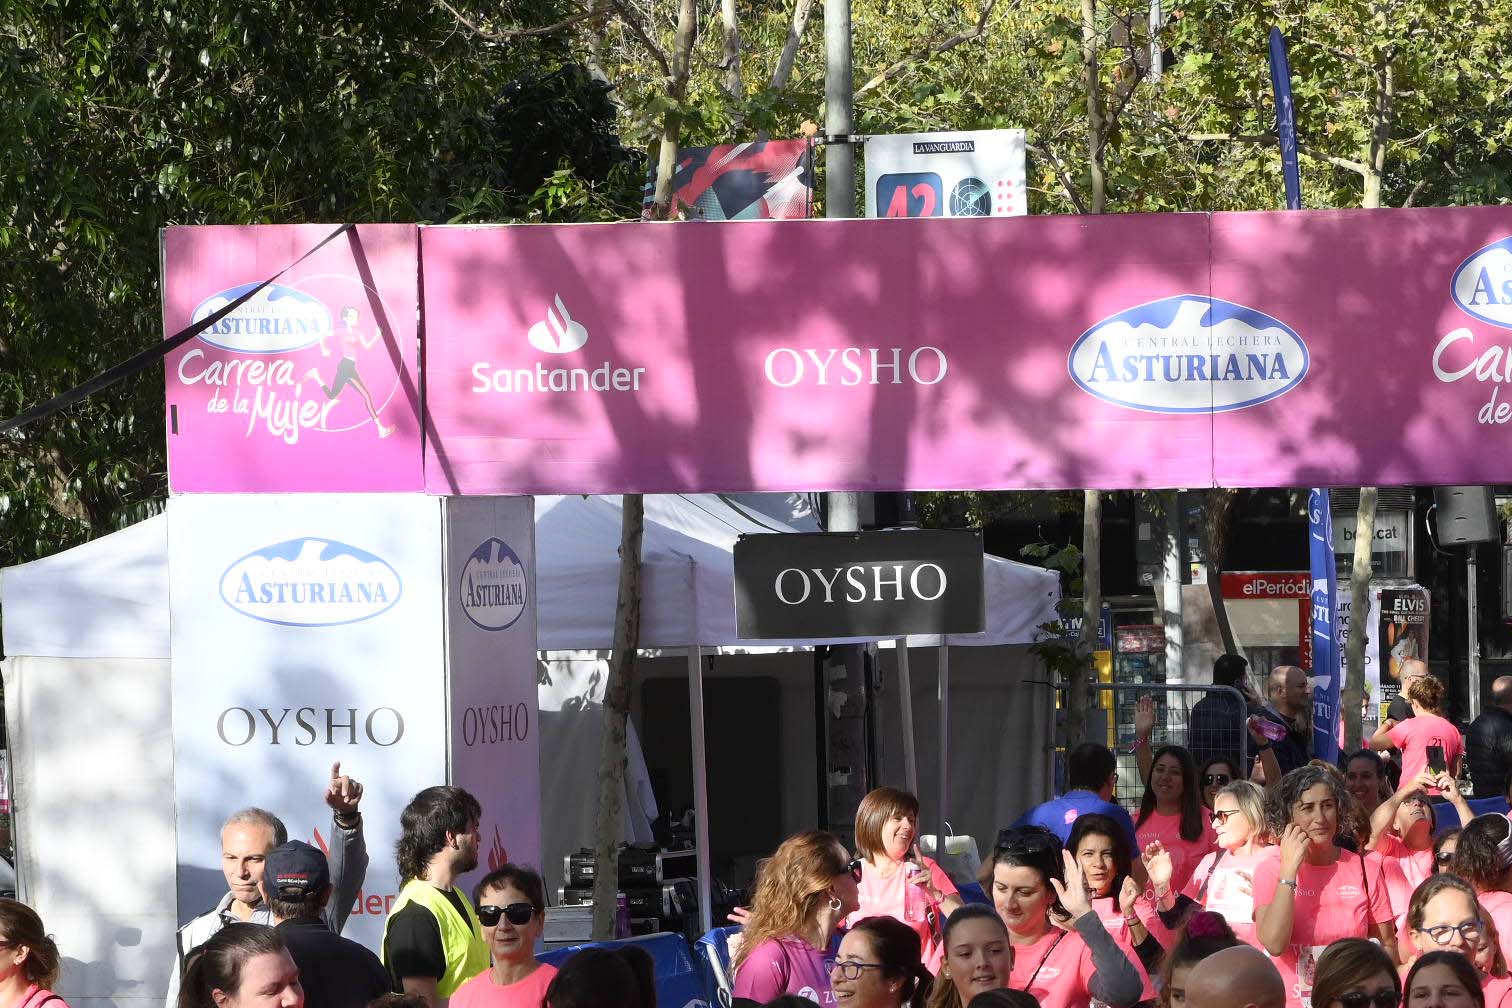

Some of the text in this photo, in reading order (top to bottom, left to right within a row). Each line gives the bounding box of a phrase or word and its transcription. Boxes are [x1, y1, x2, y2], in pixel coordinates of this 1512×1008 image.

[925, 141, 973, 152] VANGUARDIA
[178, 348, 294, 386] Carrera
[471, 361, 646, 393] Santander
[763, 345, 949, 387] OYSHO
[1087, 340, 1290, 383] ASTURIANA
[207, 381, 333, 444] de la Mujer
[1478, 391, 1512, 425] de
[236, 570, 389, 605] ASTURIANA
[465, 570, 524, 609] ASTURIANA
[775, 563, 948, 605] OYSHO
[1243, 579, 1312, 596] elPeriódi
[1394, 598, 1424, 611] ELVIS
[217, 706, 405, 747] OYSHO
[463, 702, 528, 748] OYSHO
